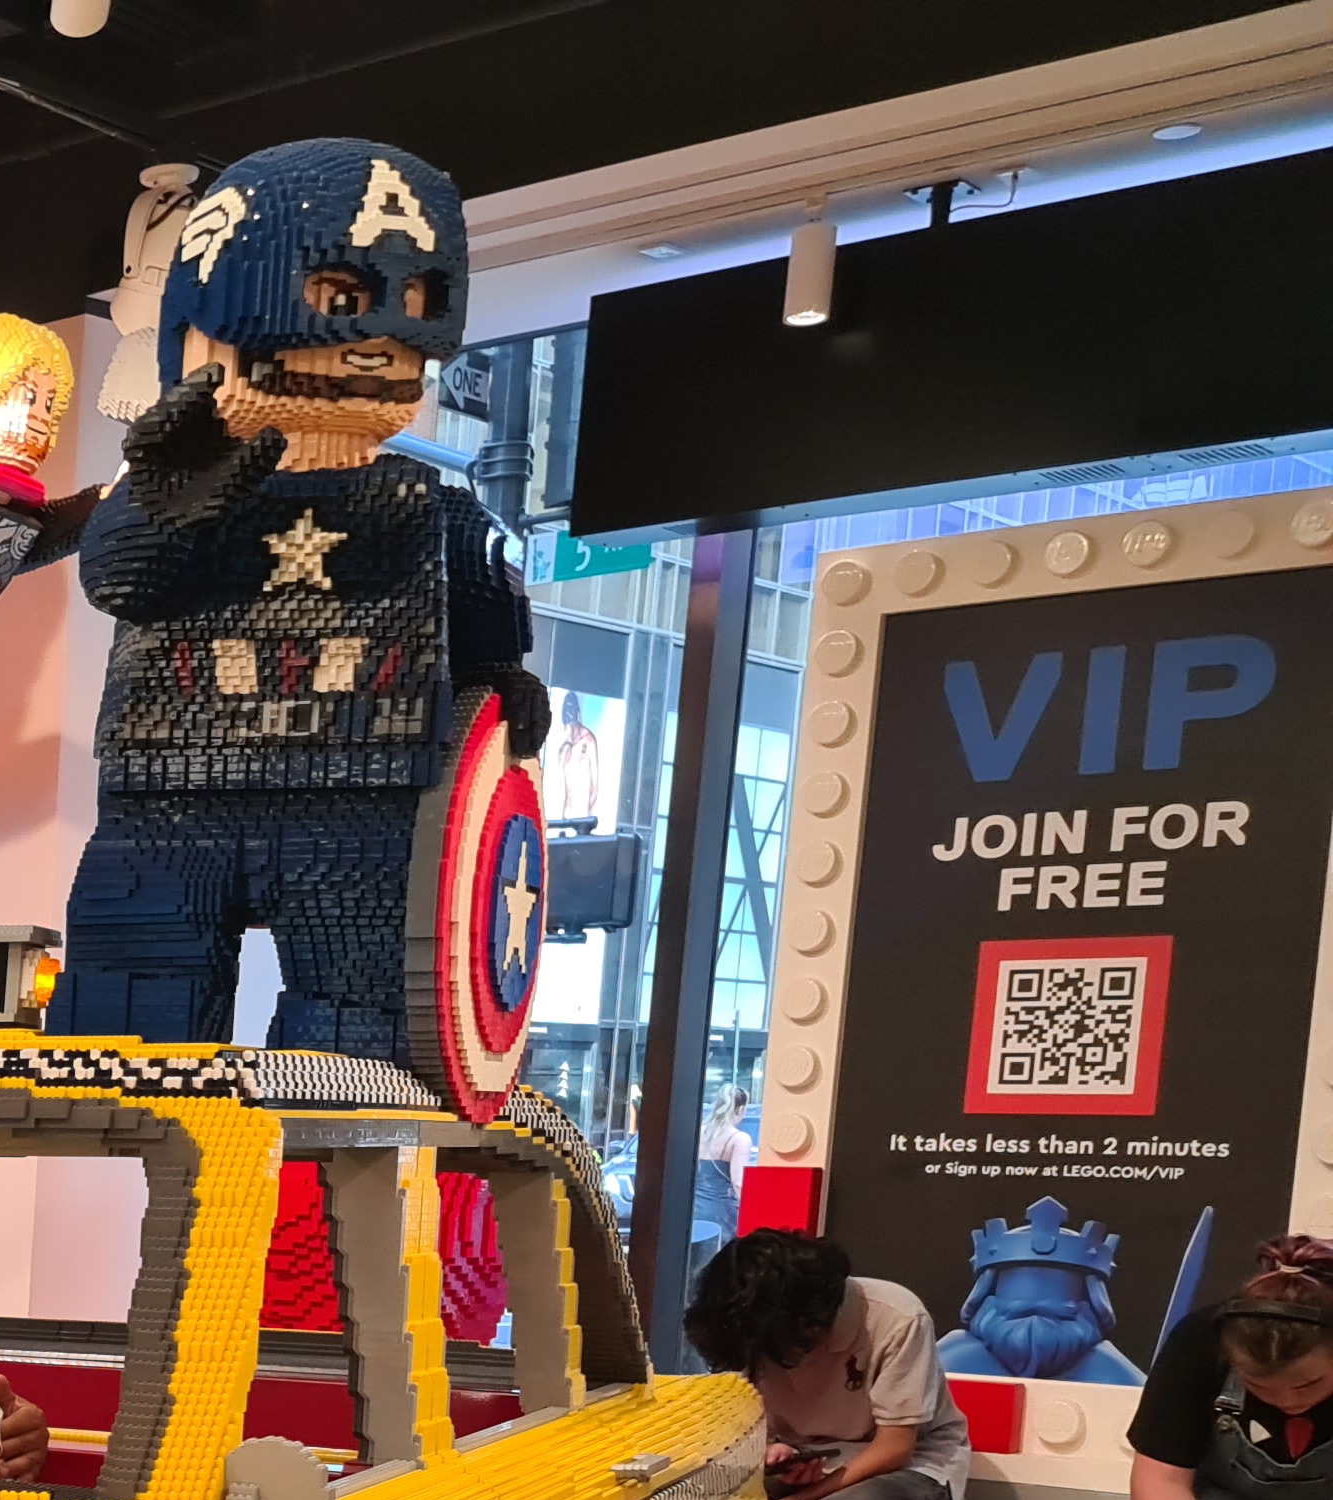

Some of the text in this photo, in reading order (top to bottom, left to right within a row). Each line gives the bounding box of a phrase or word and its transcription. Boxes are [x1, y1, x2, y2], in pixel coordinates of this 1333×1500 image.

[349, 159, 435, 252] A
[453, 366, 482, 397] ONE
[944, 635, 1275, 782] VIP
[933, 801, 1250, 862] JOIN FOR
[997, 860, 1167, 912] FREE
[890, 1132, 1230, 1158] It takes less than 2 minutes
[925, 1161, 1185, 1181] or Sign up now at LEGO.COM/VIP
